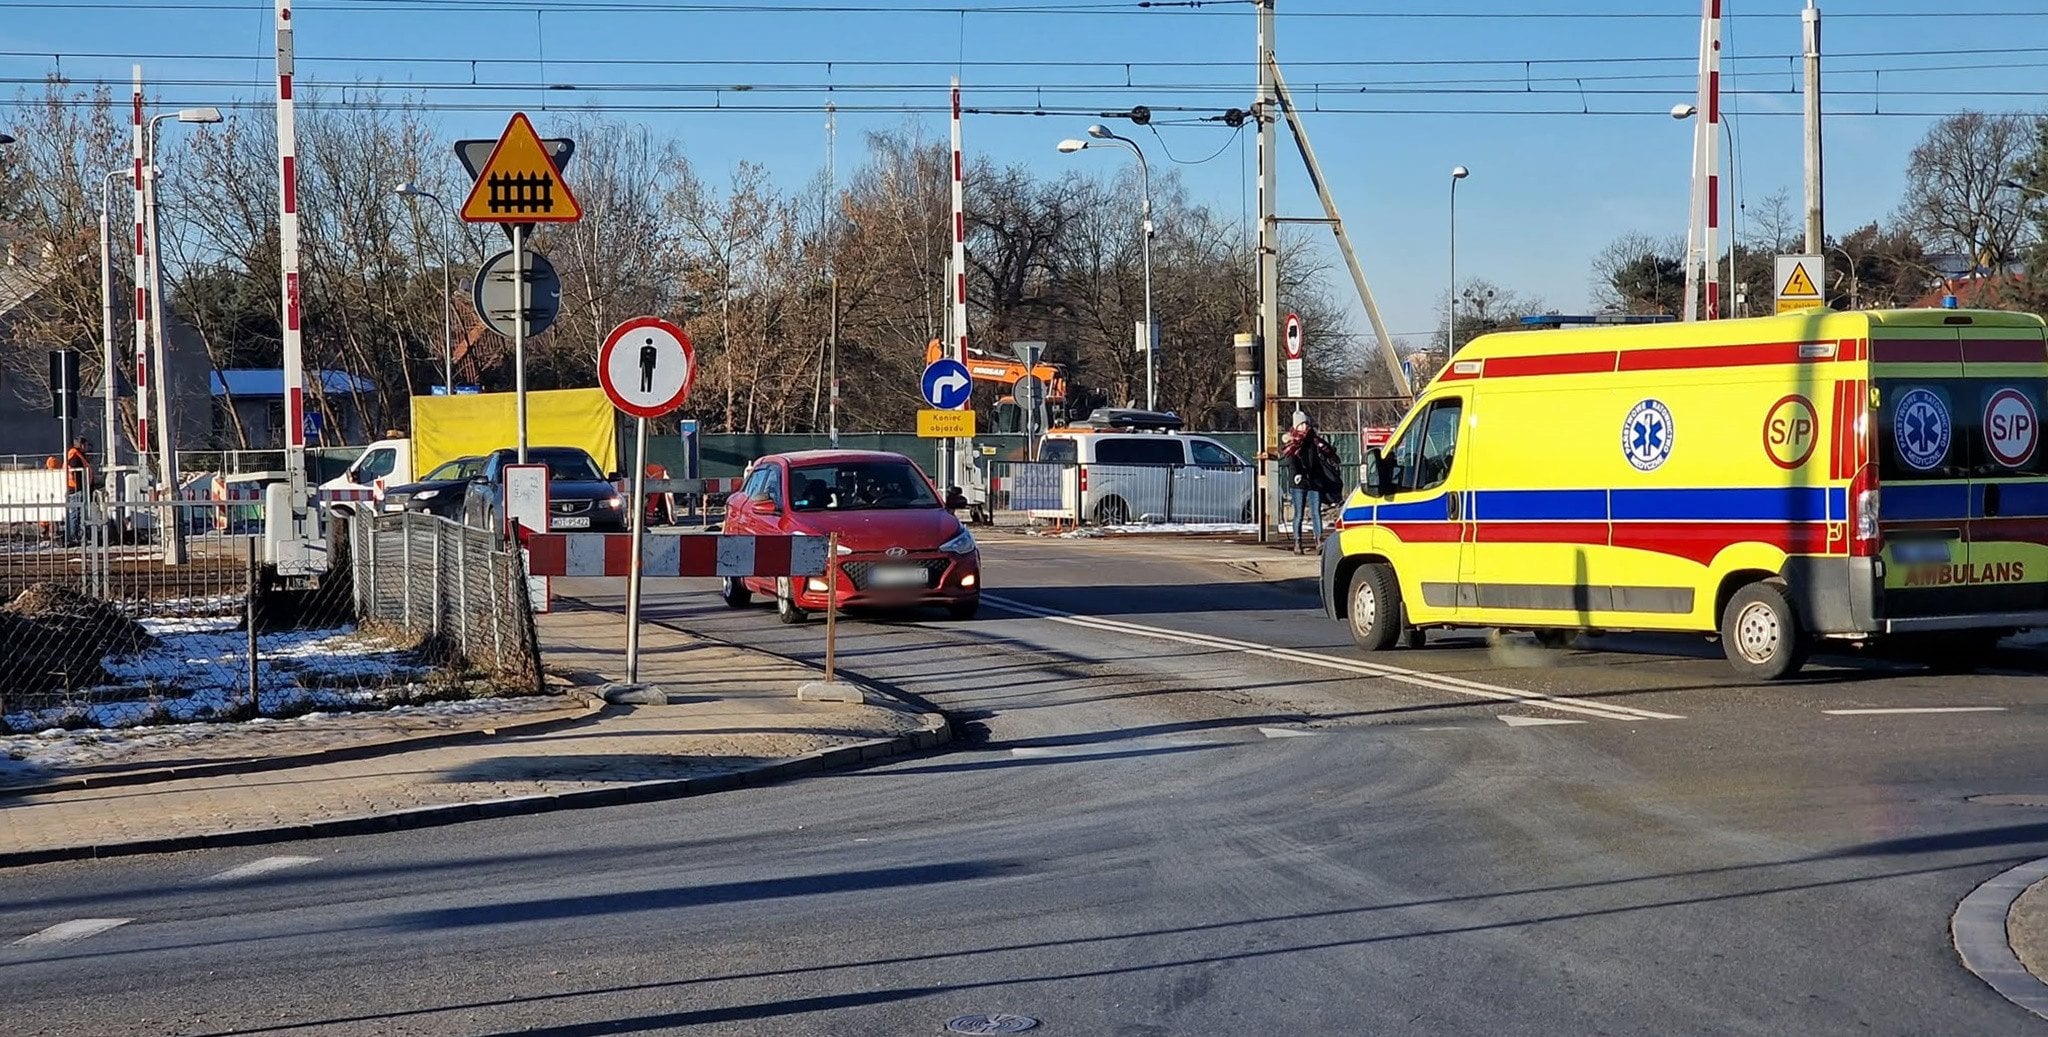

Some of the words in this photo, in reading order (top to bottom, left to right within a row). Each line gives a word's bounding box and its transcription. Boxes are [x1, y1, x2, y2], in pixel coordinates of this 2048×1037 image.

[930, 425, 964, 433] objazdu
[933, 414, 961, 422] Koniec
[1993, 414, 2030, 441] S/P
[1771, 419, 1811, 446] S/P
[1904, 561, 2024, 587] AMBULANS
